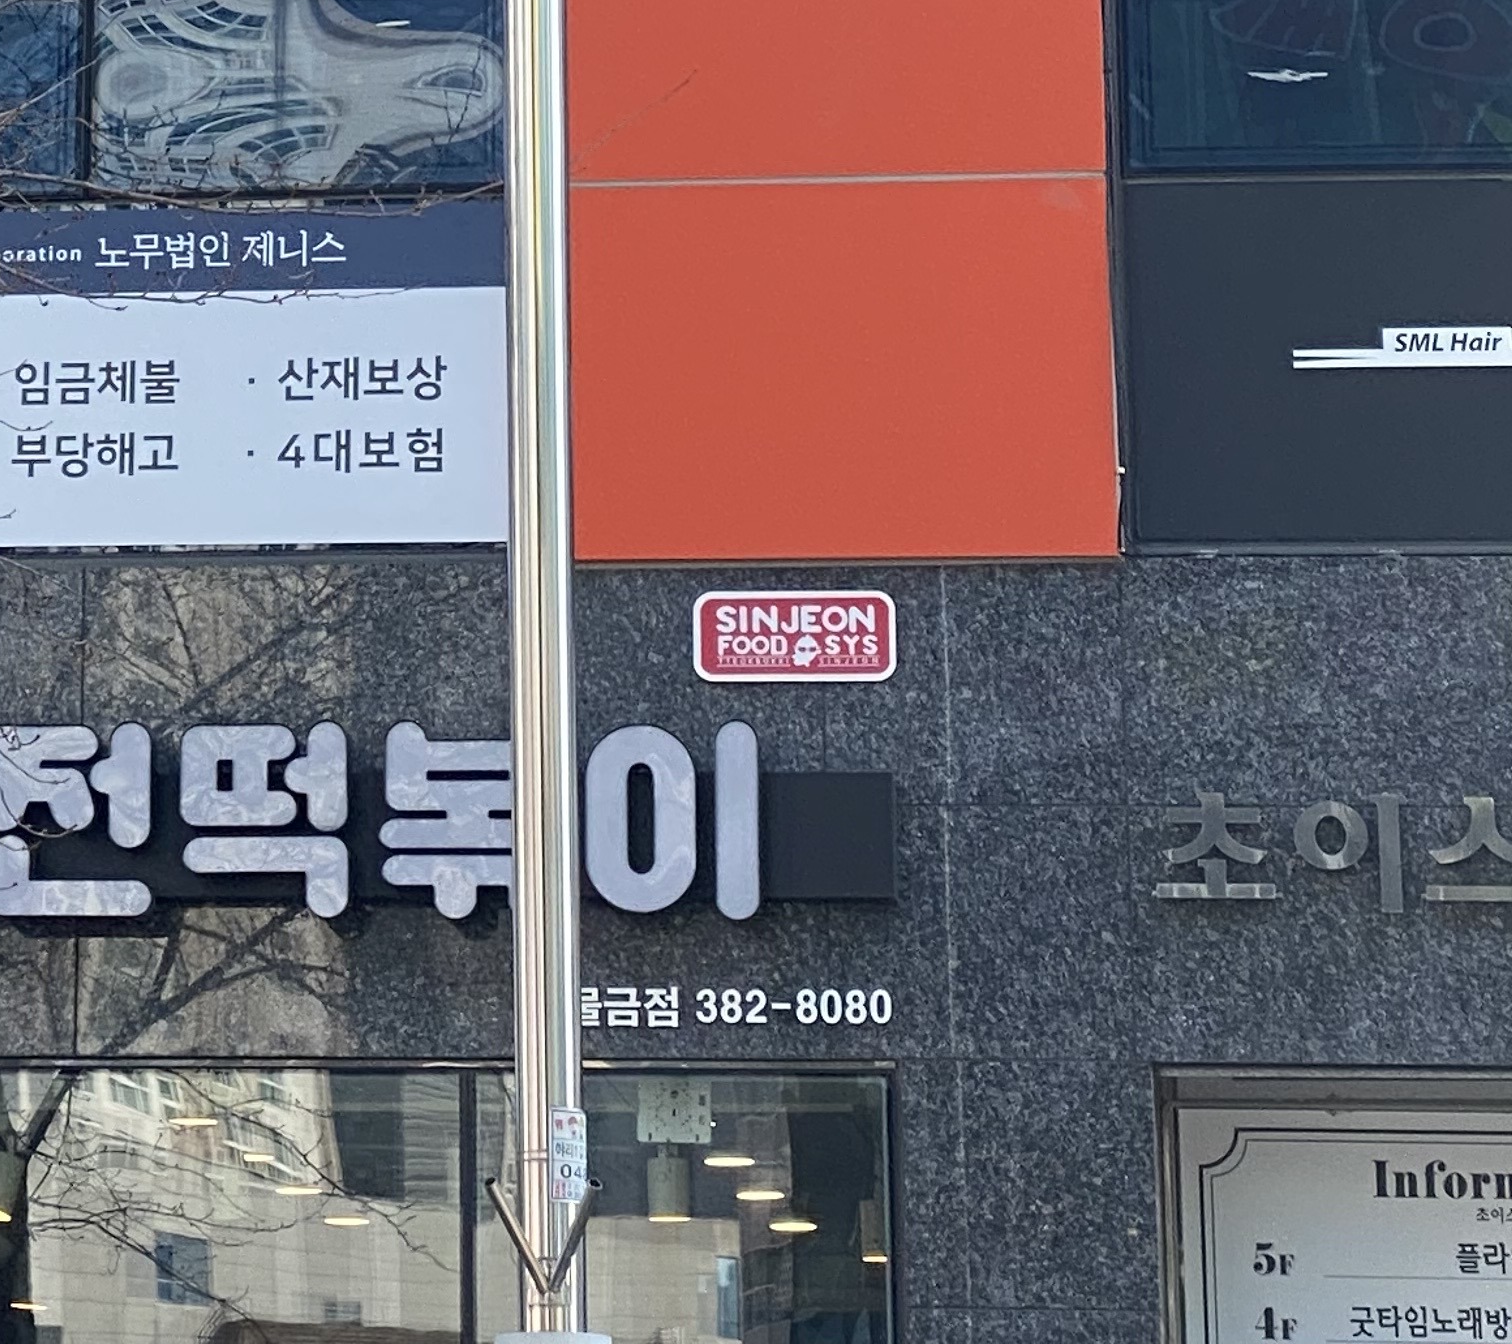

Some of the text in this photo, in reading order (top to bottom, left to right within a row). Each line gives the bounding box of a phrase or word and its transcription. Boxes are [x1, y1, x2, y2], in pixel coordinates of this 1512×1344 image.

[95, 231, 231, 270] 노무법인
[241, 229, 347, 267] 제니스
[1394, 331, 1503, 353] SML Hair
[14, 359, 180, 406] 임금체불
[277, 355, 448, 401] 산재보상
[11, 431, 179, 478] 부당해고
[276, 427, 445, 474] 4대보험
[715, 604, 876, 634] SINJEON
[717, 634, 879, 656] FOOD SYS
[695, 988, 893, 1026] 382-8080
[1253, 1241, 1295, 1276] 5F
[1254, 1305, 1298, 1341] 4F
[1349, 1305, 1512, 1340] 굿타임노래방
